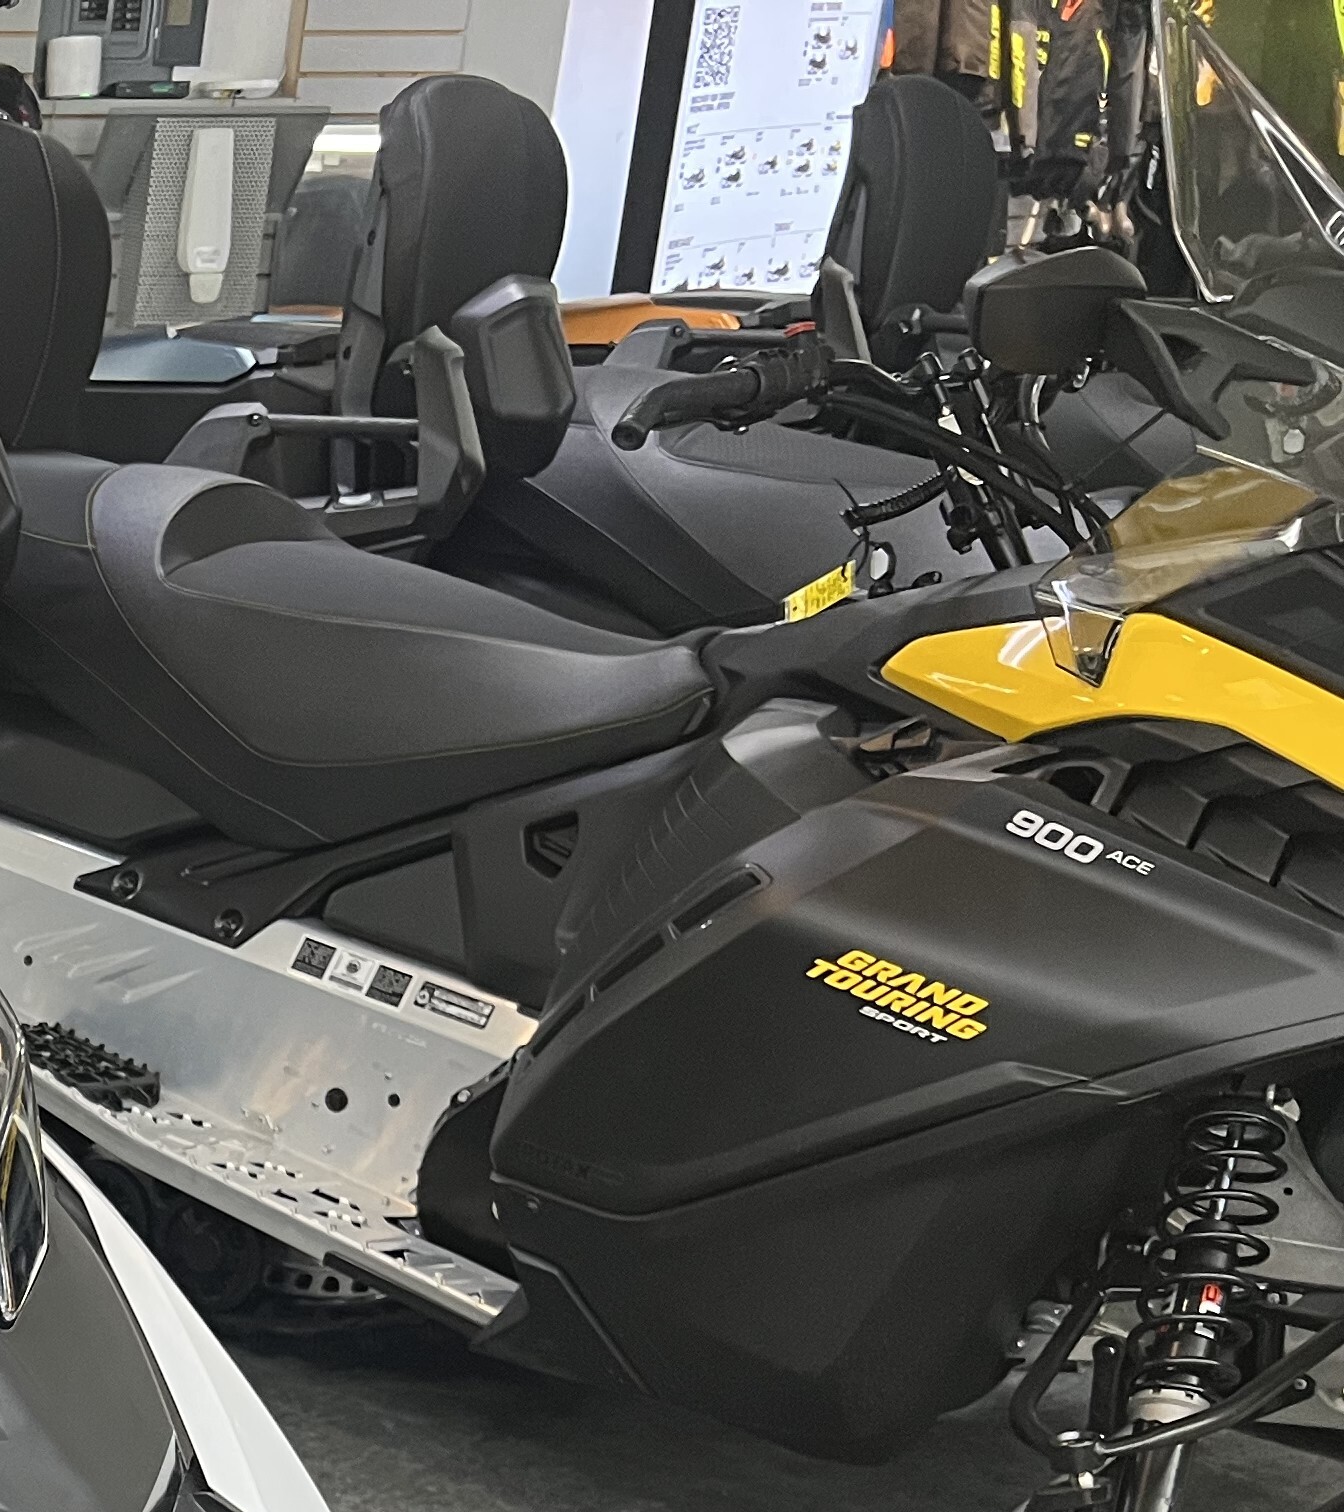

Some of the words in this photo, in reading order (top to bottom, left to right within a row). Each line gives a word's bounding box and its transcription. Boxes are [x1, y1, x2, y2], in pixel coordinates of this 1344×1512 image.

[1005, 808, 1104, 864] 900
[1106, 850, 1156, 876] ACE
[805, 958, 988, 1040] TOURING
[836, 949, 989, 1016] GRAND
[858, 1005, 948, 1045] SPORT
